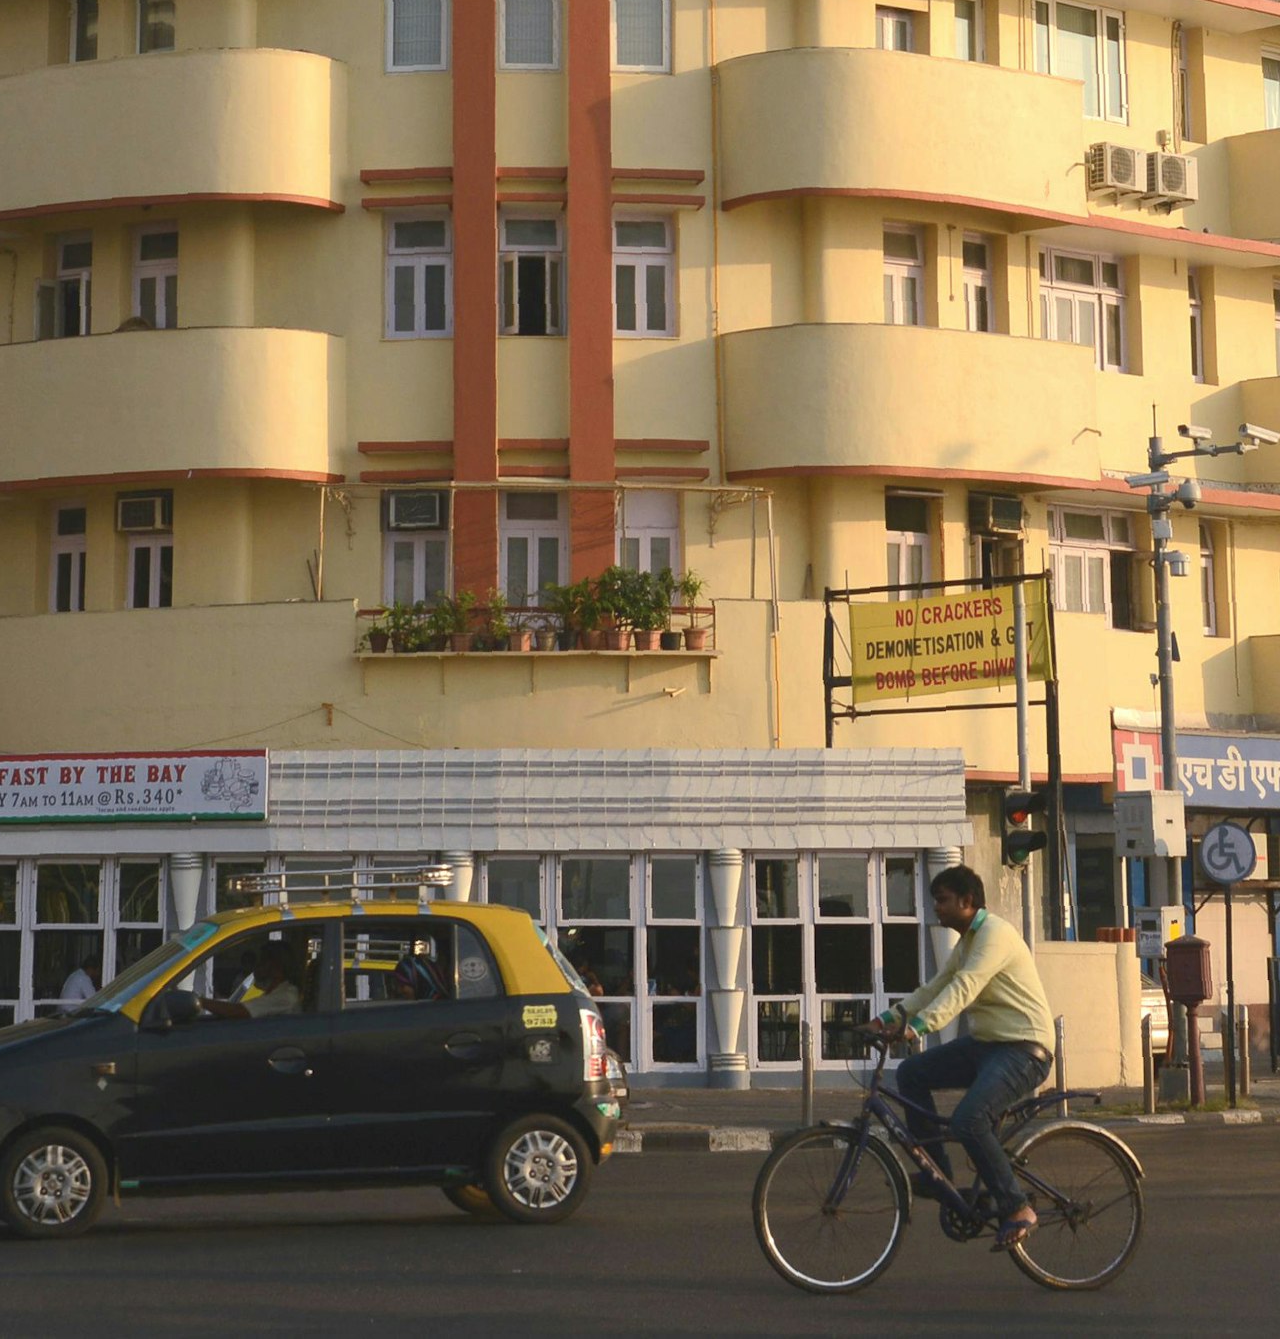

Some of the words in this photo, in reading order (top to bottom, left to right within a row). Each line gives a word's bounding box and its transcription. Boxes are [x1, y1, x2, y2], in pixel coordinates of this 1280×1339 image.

[896, 609, 913, 627] NO
[922, 597, 1003, 624] CRACKERS
[867, 630, 984, 660] DEMONETISATION
[991, 628, 1001, 647] &
[1006, 622, 1034, 644] GT
[876, 669, 916, 690] BOMB
[922, 661, 978, 686] BEFORE
[983, 654, 1031, 678] DIWAI
[59, 766, 86, 785] BY
[96, 764, 136, 784] THE
[146, 763, 187, 783] BAY
[12, 792, 38, 808] 7AM
[42, 794, 56, 807] TO
[61, 791, 94, 807] 11AM
[97, 791, 112, 807] @
